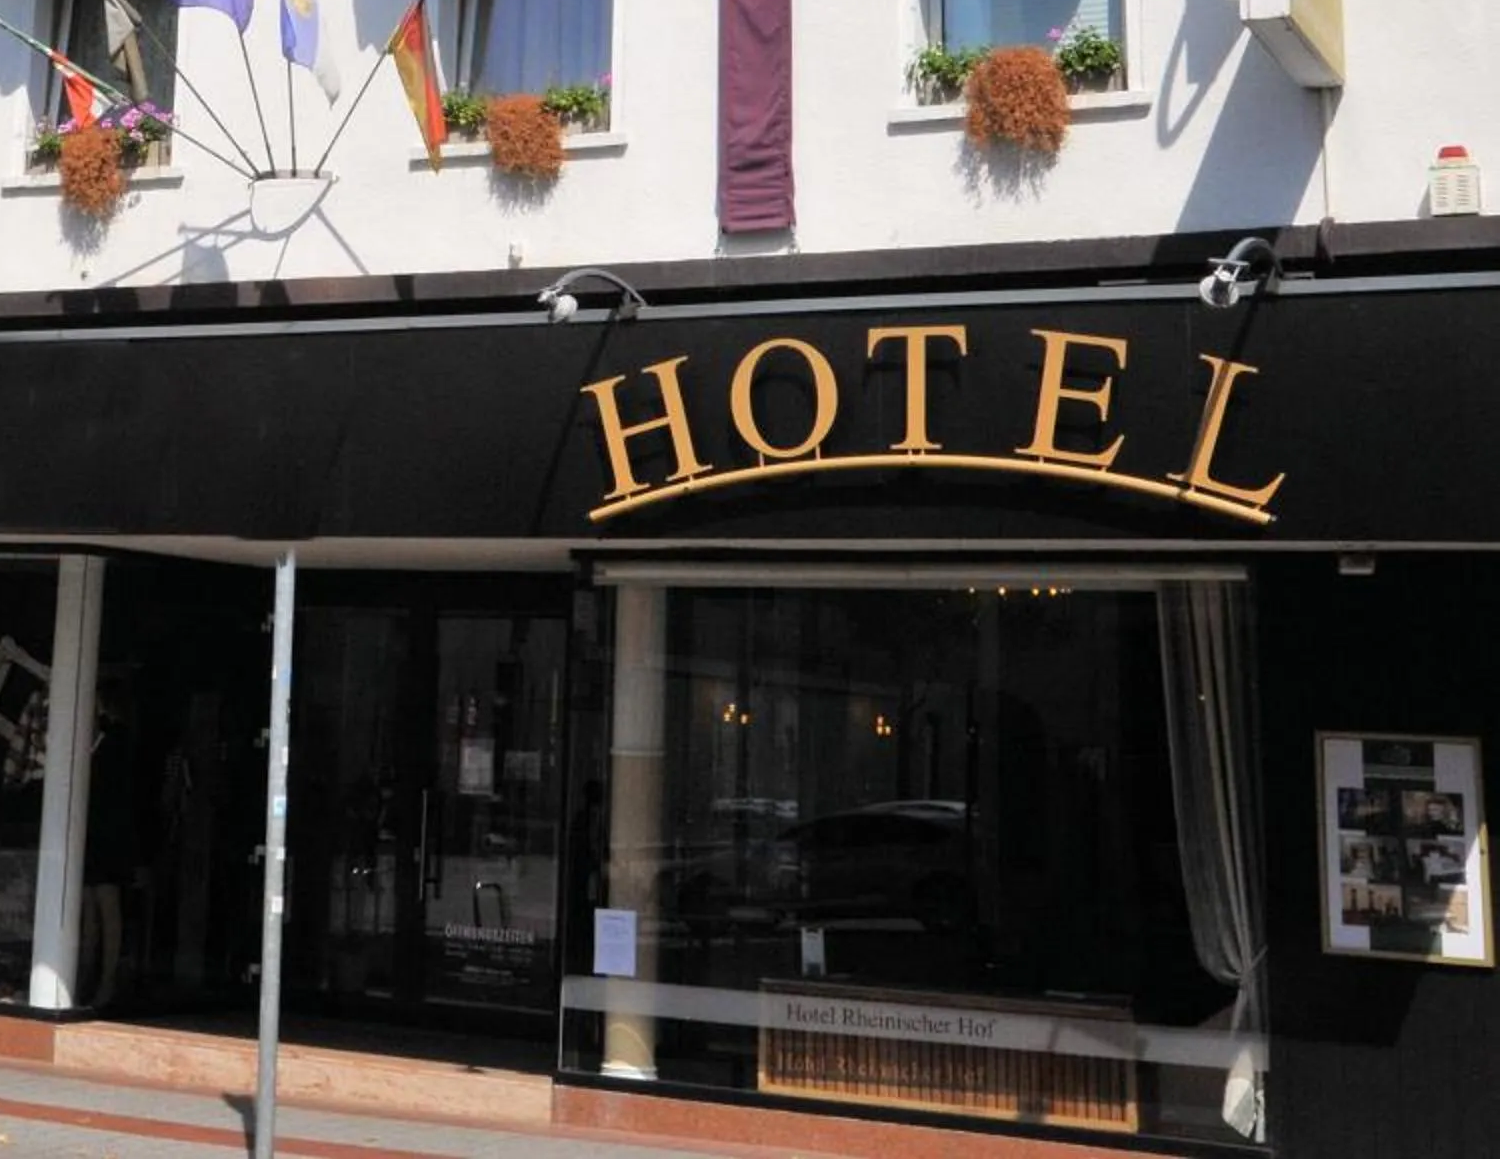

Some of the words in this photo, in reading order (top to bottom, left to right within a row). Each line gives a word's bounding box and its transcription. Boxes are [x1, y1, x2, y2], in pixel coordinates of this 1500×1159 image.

[581, 324, 1285, 505] HOTEL
[786, 1002, 836, 1026] Hotel
[842, 1008, 951, 1035] Rheinischer
[958, 1016, 998, 1040] Hof
